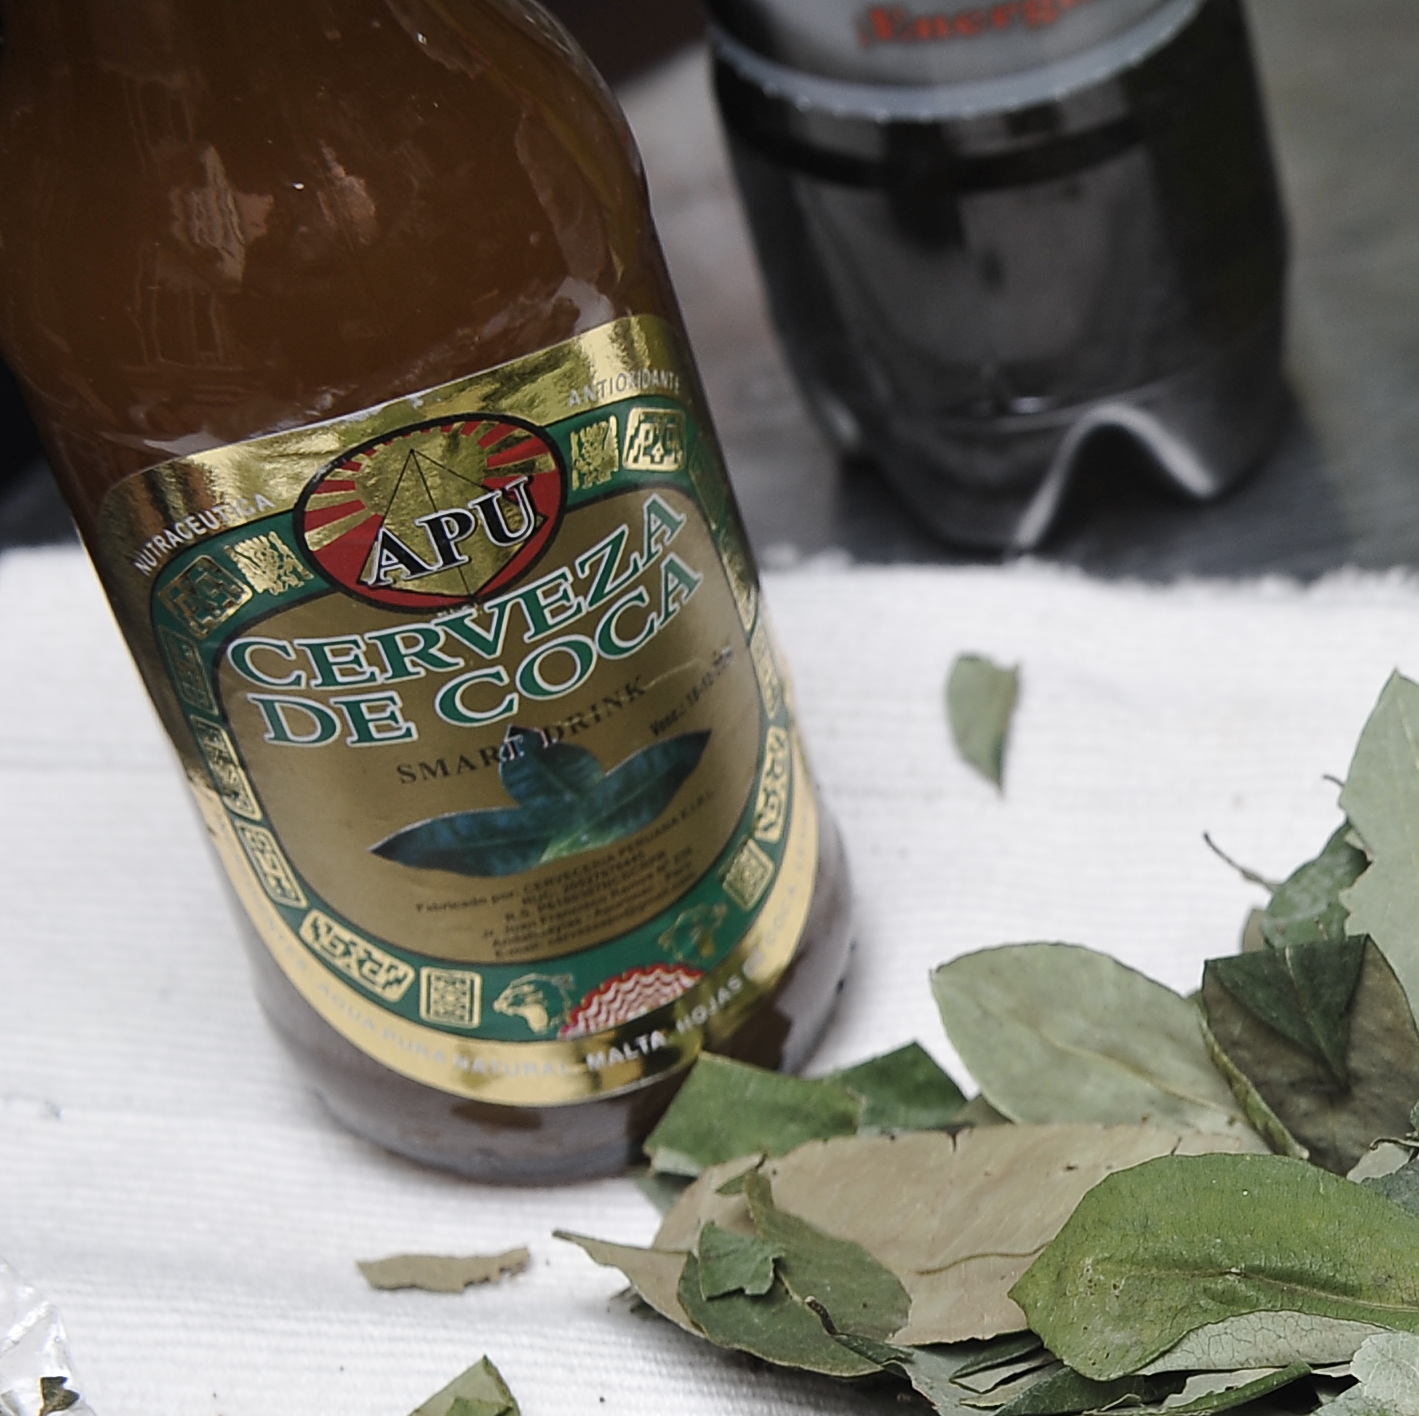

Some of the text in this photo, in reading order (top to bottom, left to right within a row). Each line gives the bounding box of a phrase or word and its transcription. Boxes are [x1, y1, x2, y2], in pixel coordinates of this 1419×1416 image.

[568, 368, 680, 407] ANTIOXIDANTE
[134, 492, 275, 575] NUTRACEUTICA
[369, 480, 543, 589] APU
[229, 492, 686, 692] CERVEZA
[247, 690, 418, 748] DE
[439, 555, 703, 727] COCA
[397, 675, 647, 784] SMART DRINK
[585, 1030, 667, 1071] MALTA
